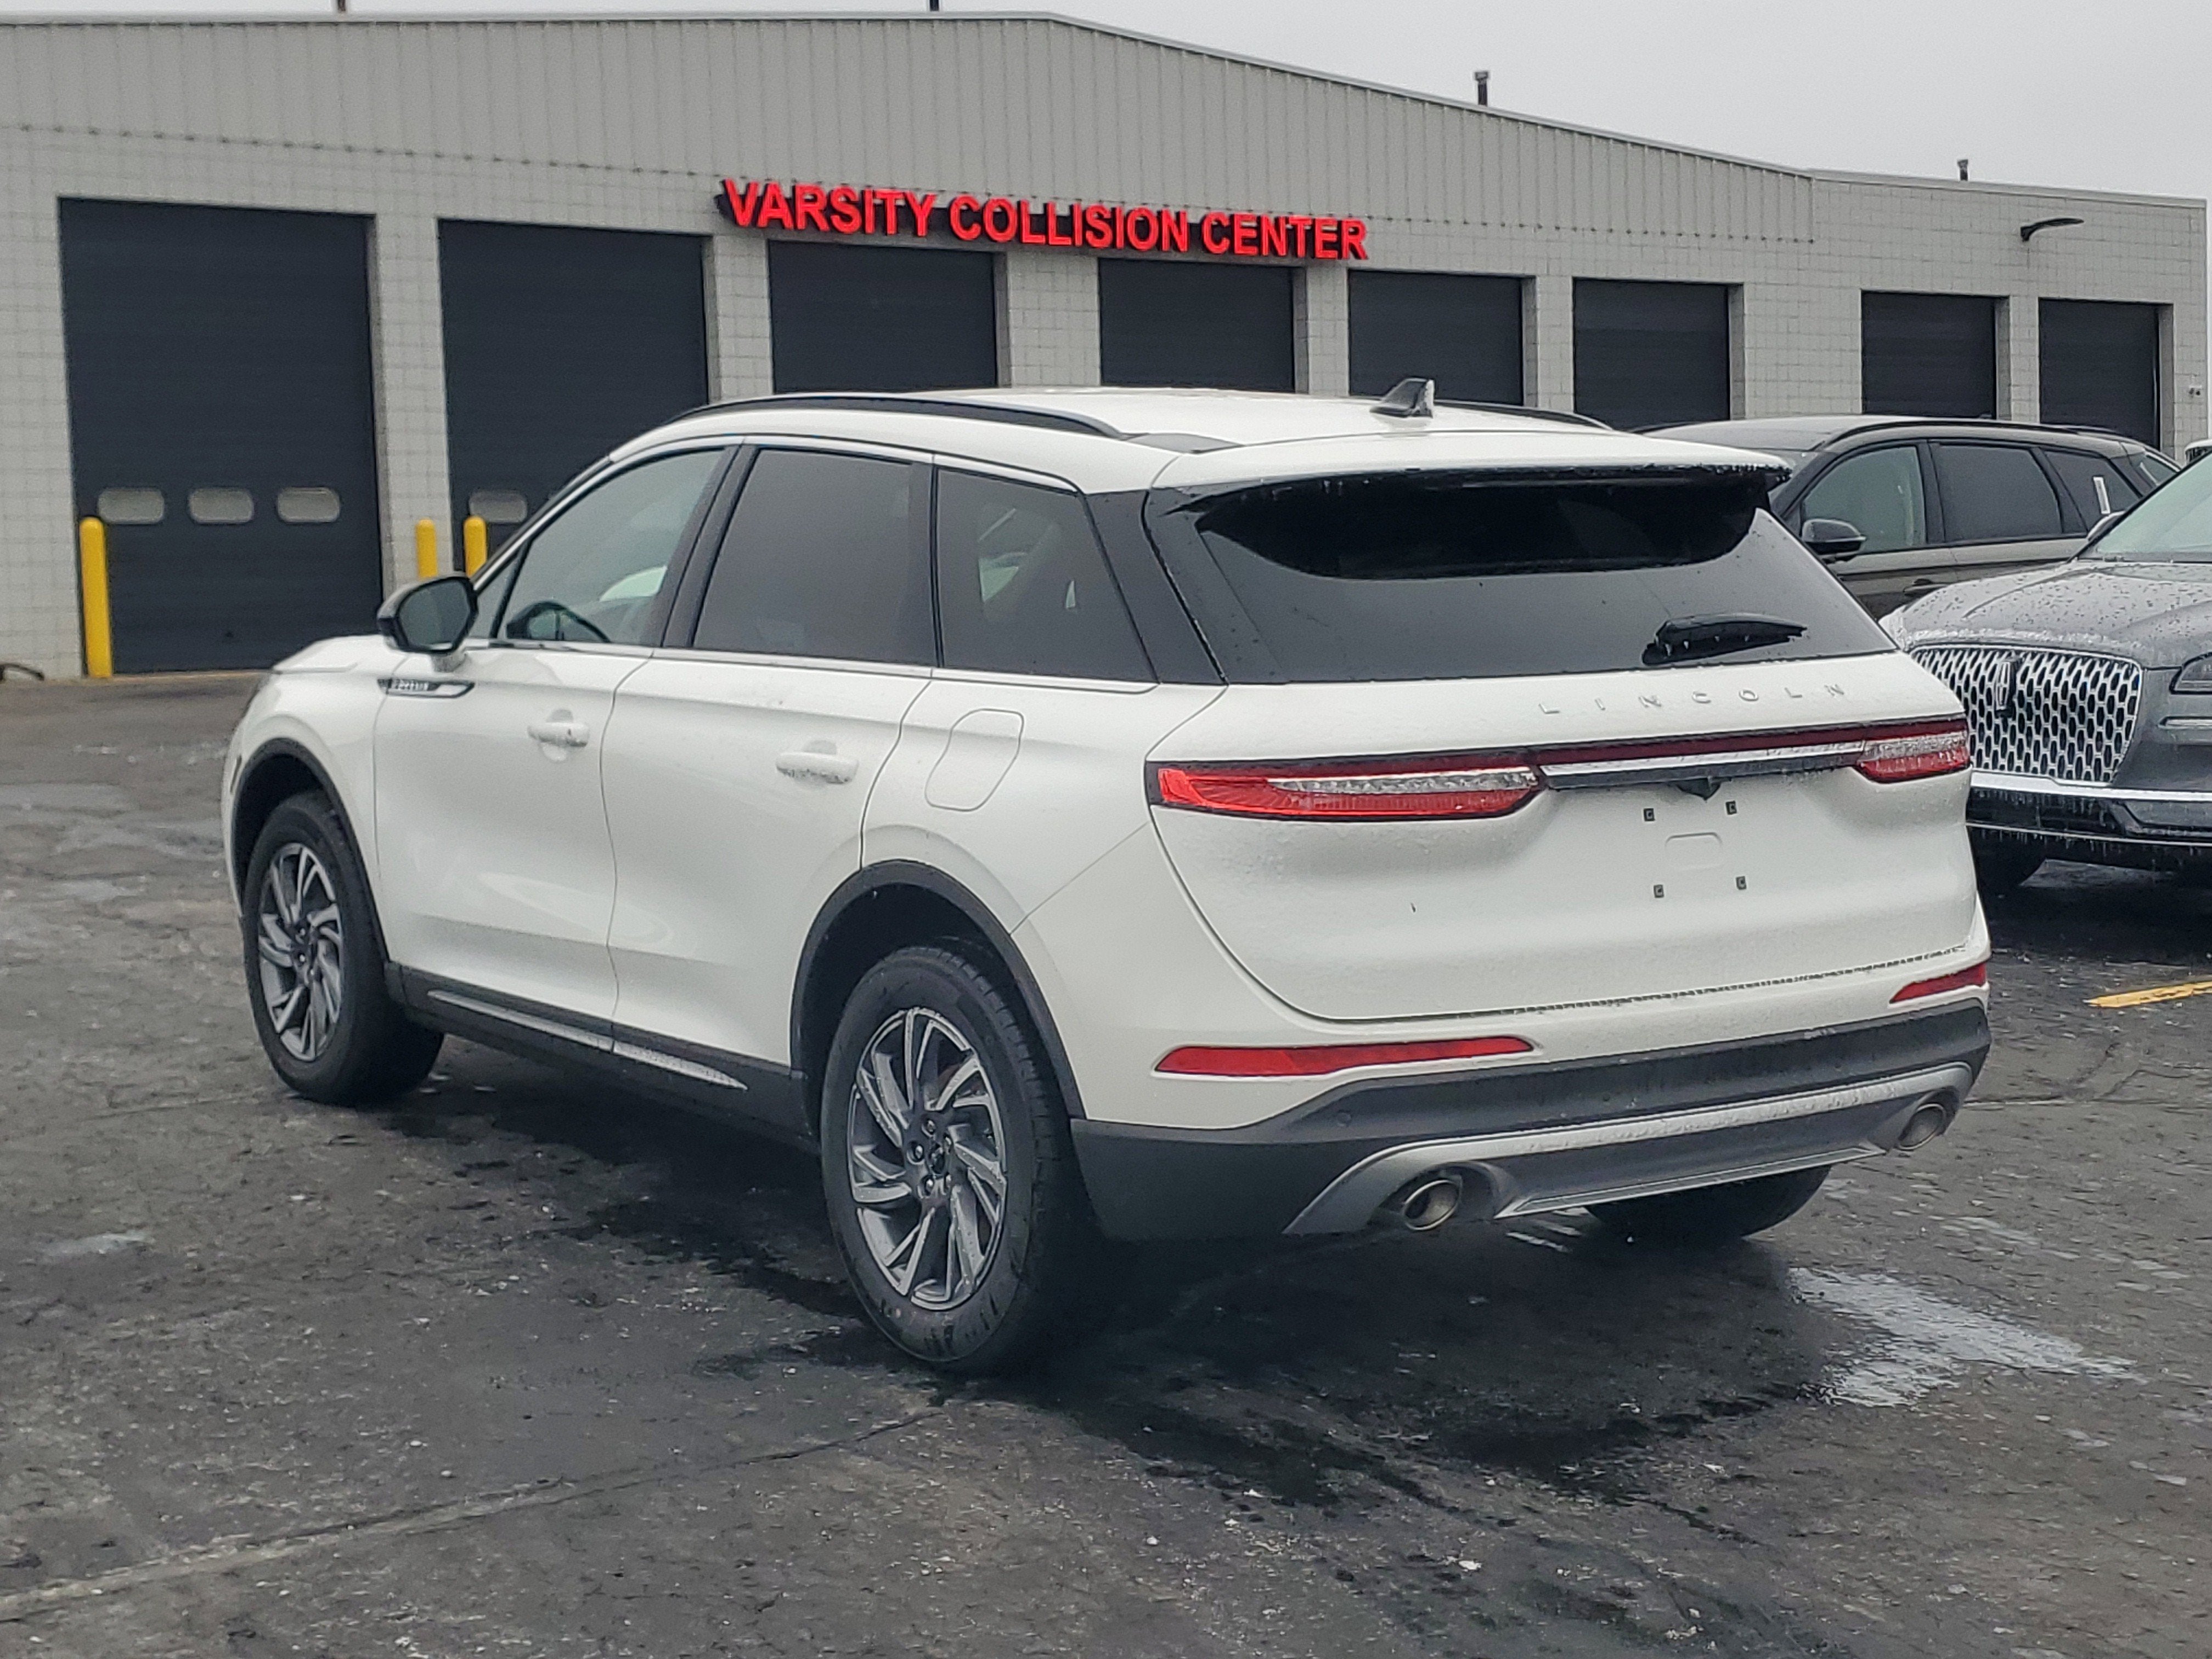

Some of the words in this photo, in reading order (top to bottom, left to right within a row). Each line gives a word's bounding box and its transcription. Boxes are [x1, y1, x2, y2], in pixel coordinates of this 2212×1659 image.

[723, 178, 937, 238] VARSITY
[949, 194, 1190, 253] COLLISION
[1201, 211, 1367, 260] CENTER
[1538, 682, 1846, 714] LINCOLN
